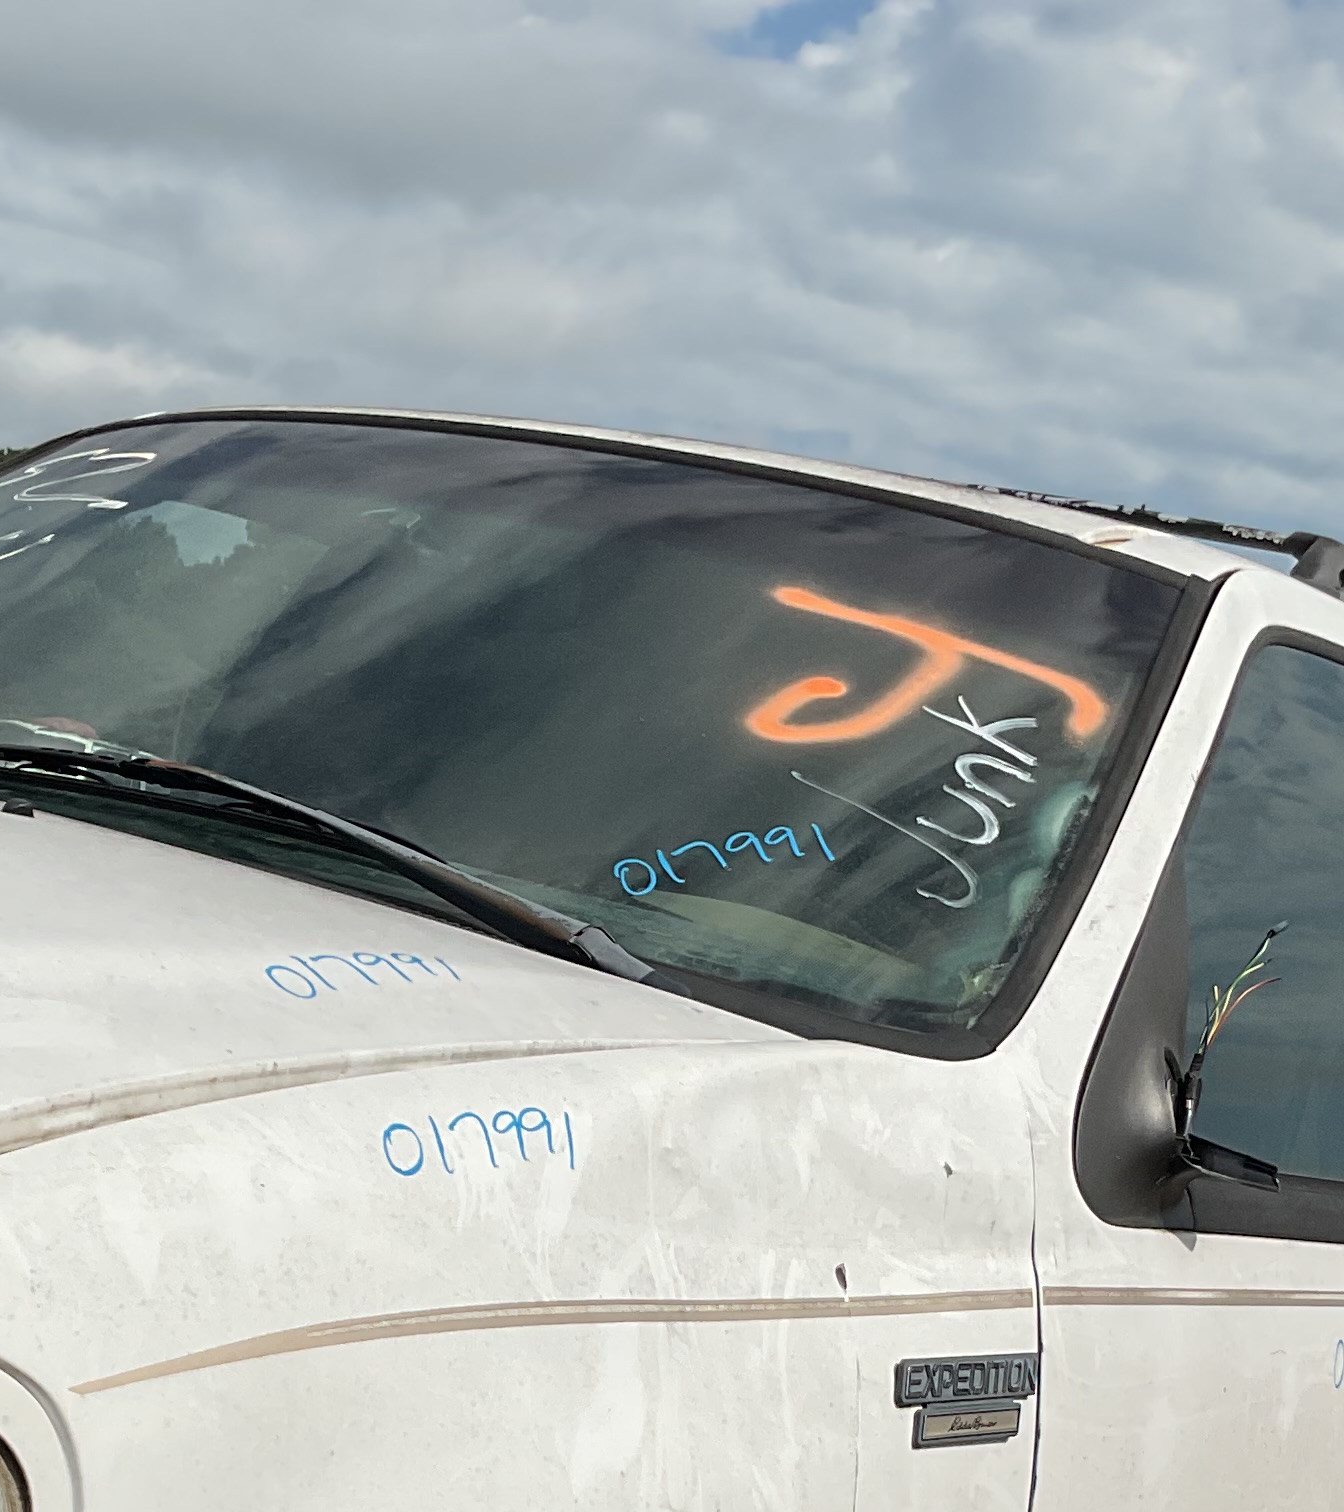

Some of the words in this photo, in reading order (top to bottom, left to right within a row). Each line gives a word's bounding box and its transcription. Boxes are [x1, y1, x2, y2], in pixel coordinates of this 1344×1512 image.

[744, 584, 1108, 744] J
[613, 822, 836, 897] 017991
[265, 951, 462, 1000] 017991
[382, 1106, 576, 1177] 017991
[905, 1357, 1038, 1400] EXPEDITION
